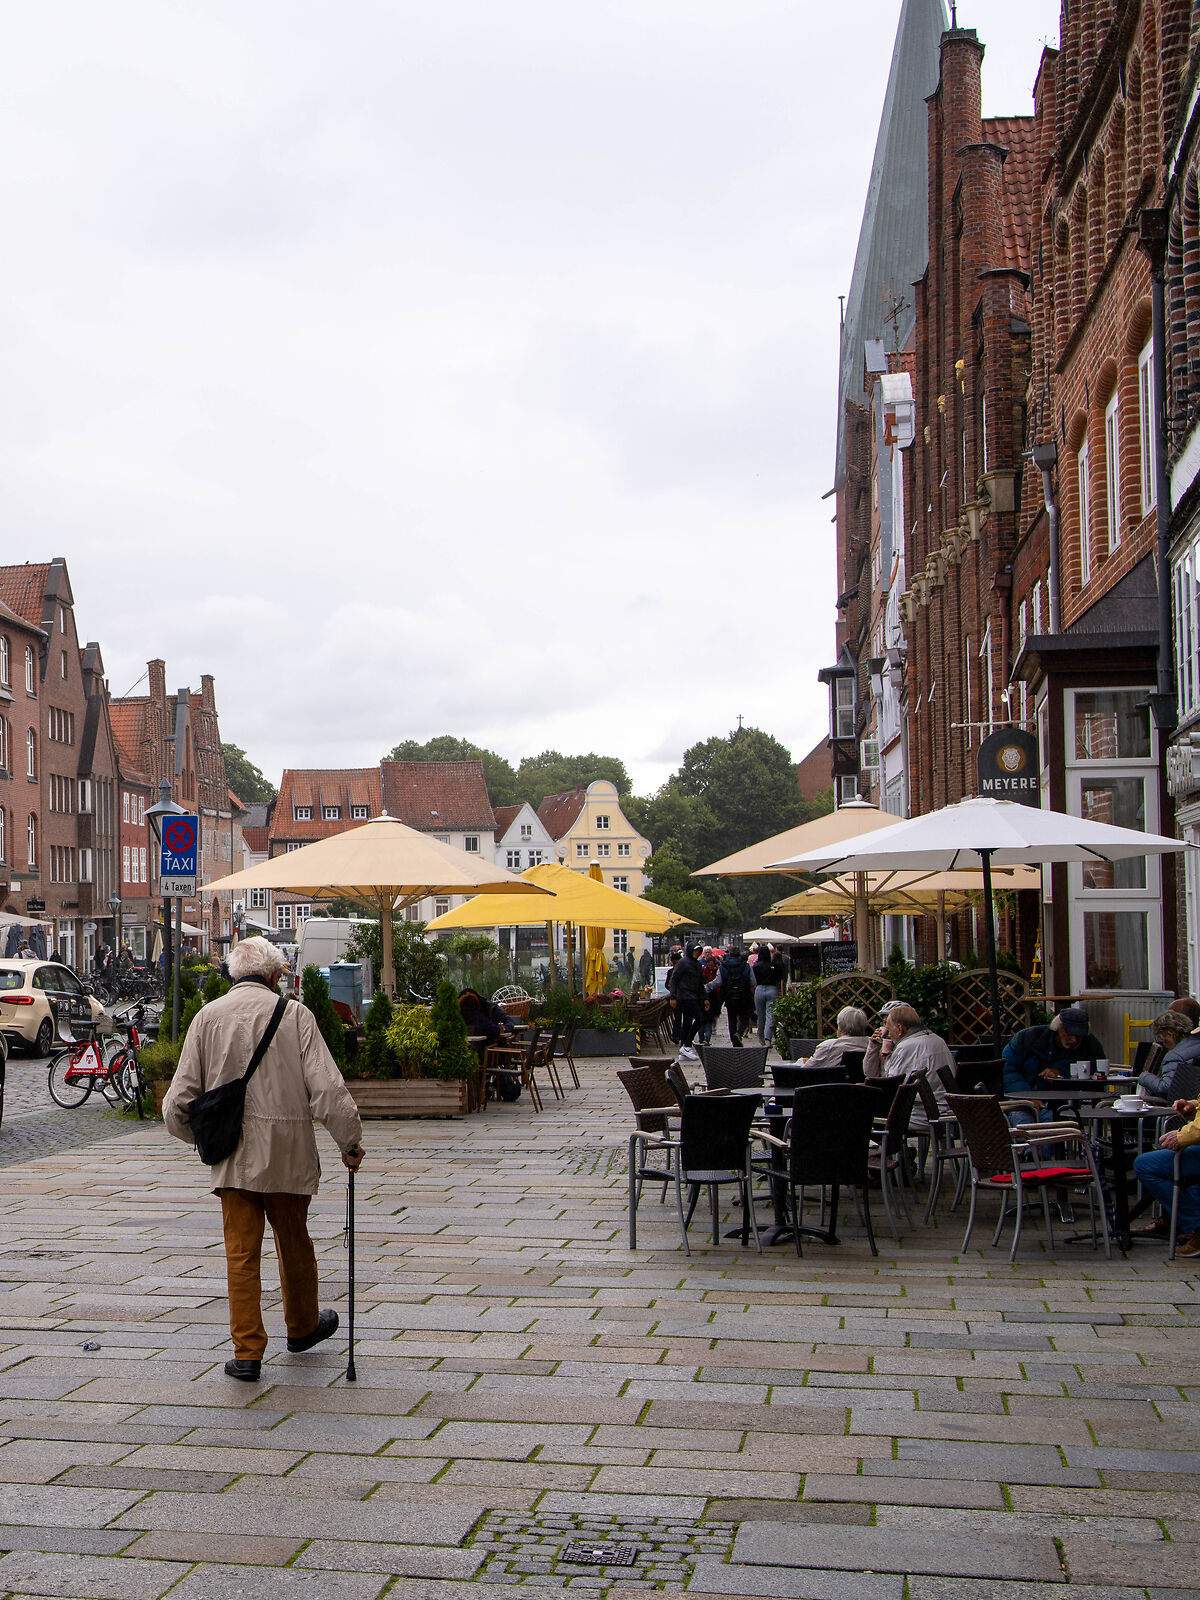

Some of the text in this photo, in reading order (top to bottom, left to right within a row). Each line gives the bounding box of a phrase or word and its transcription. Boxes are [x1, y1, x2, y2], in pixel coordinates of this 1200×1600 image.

[982, 777, 1037, 790] MEYERE
[164, 857, 193, 871] TAXI
[164, 882, 192, 892] 4 Taxen
